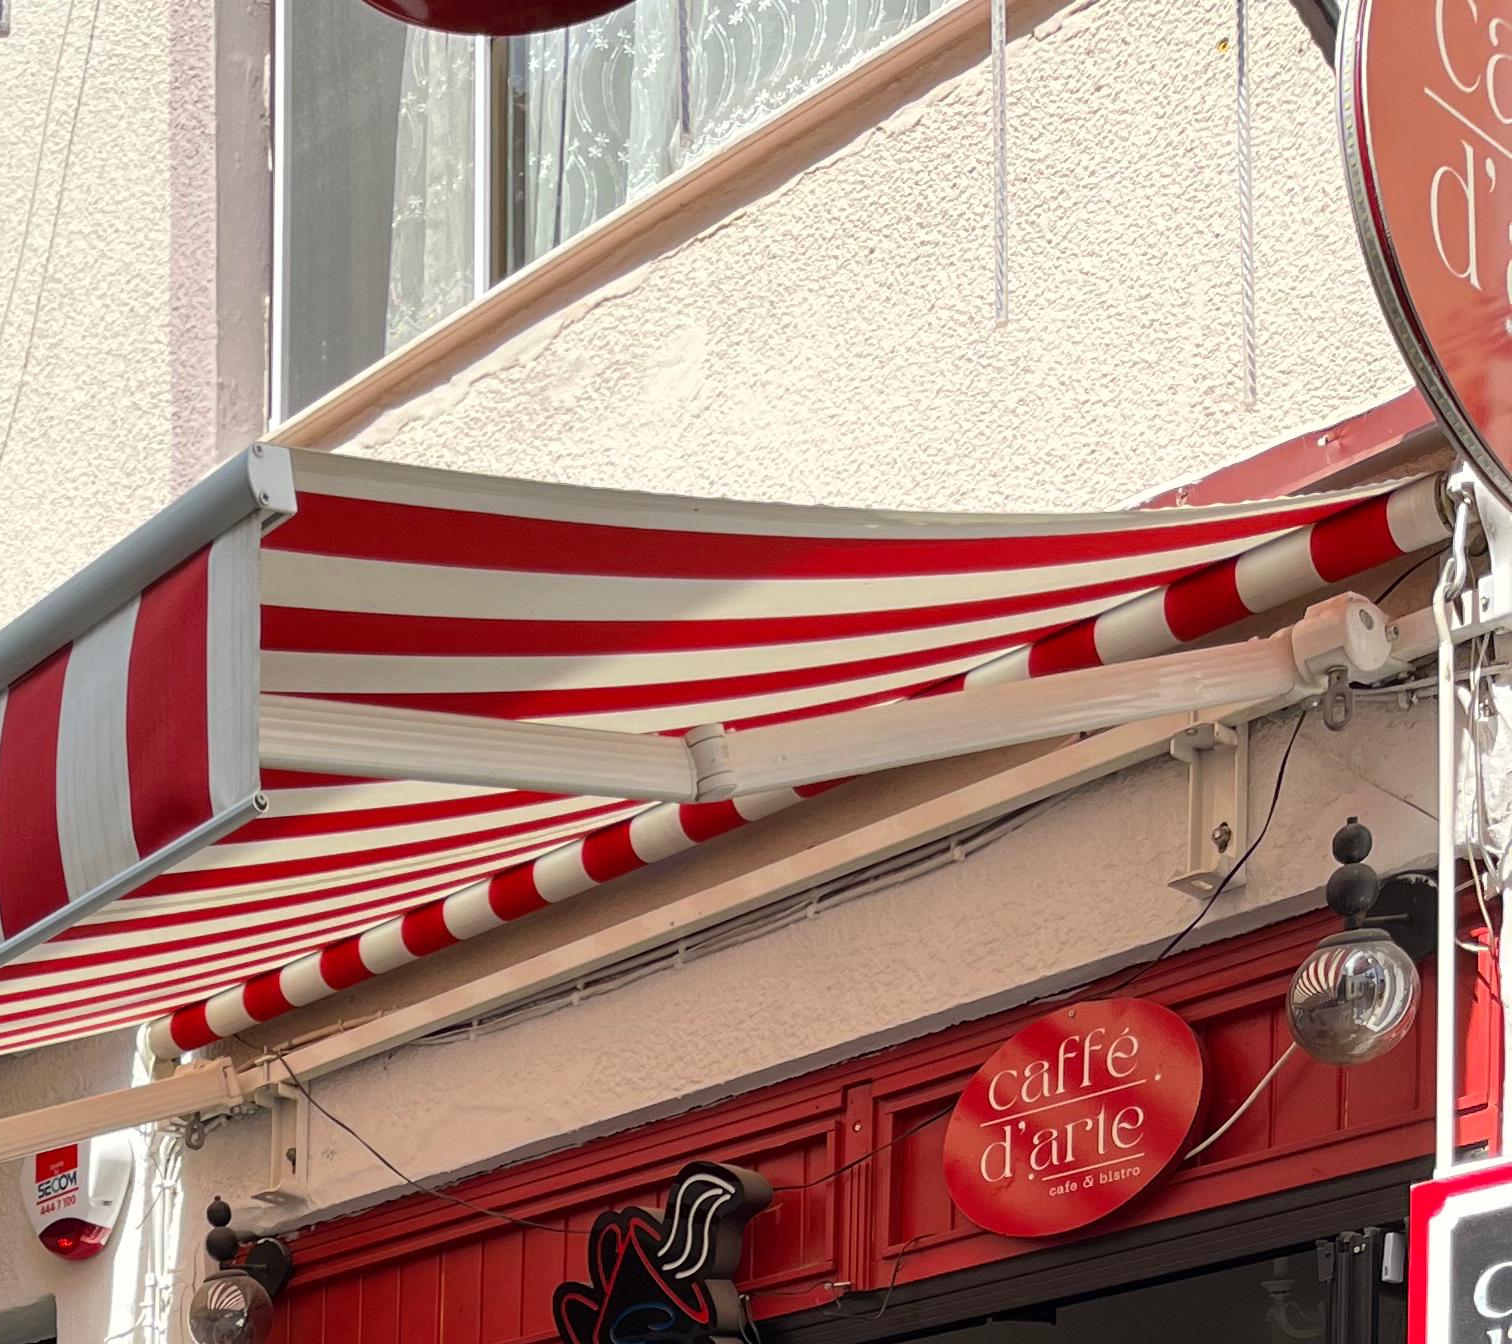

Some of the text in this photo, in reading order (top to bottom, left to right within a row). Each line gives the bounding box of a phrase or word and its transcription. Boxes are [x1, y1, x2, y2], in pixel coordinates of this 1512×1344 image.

[989, 1027, 1139, 1110] caffé
[980, 1104, 1144, 1182] d'arte
[37, 1170, 77, 1199] SECOM
[1049, 1165, 1140, 1197] cafe & bistro
